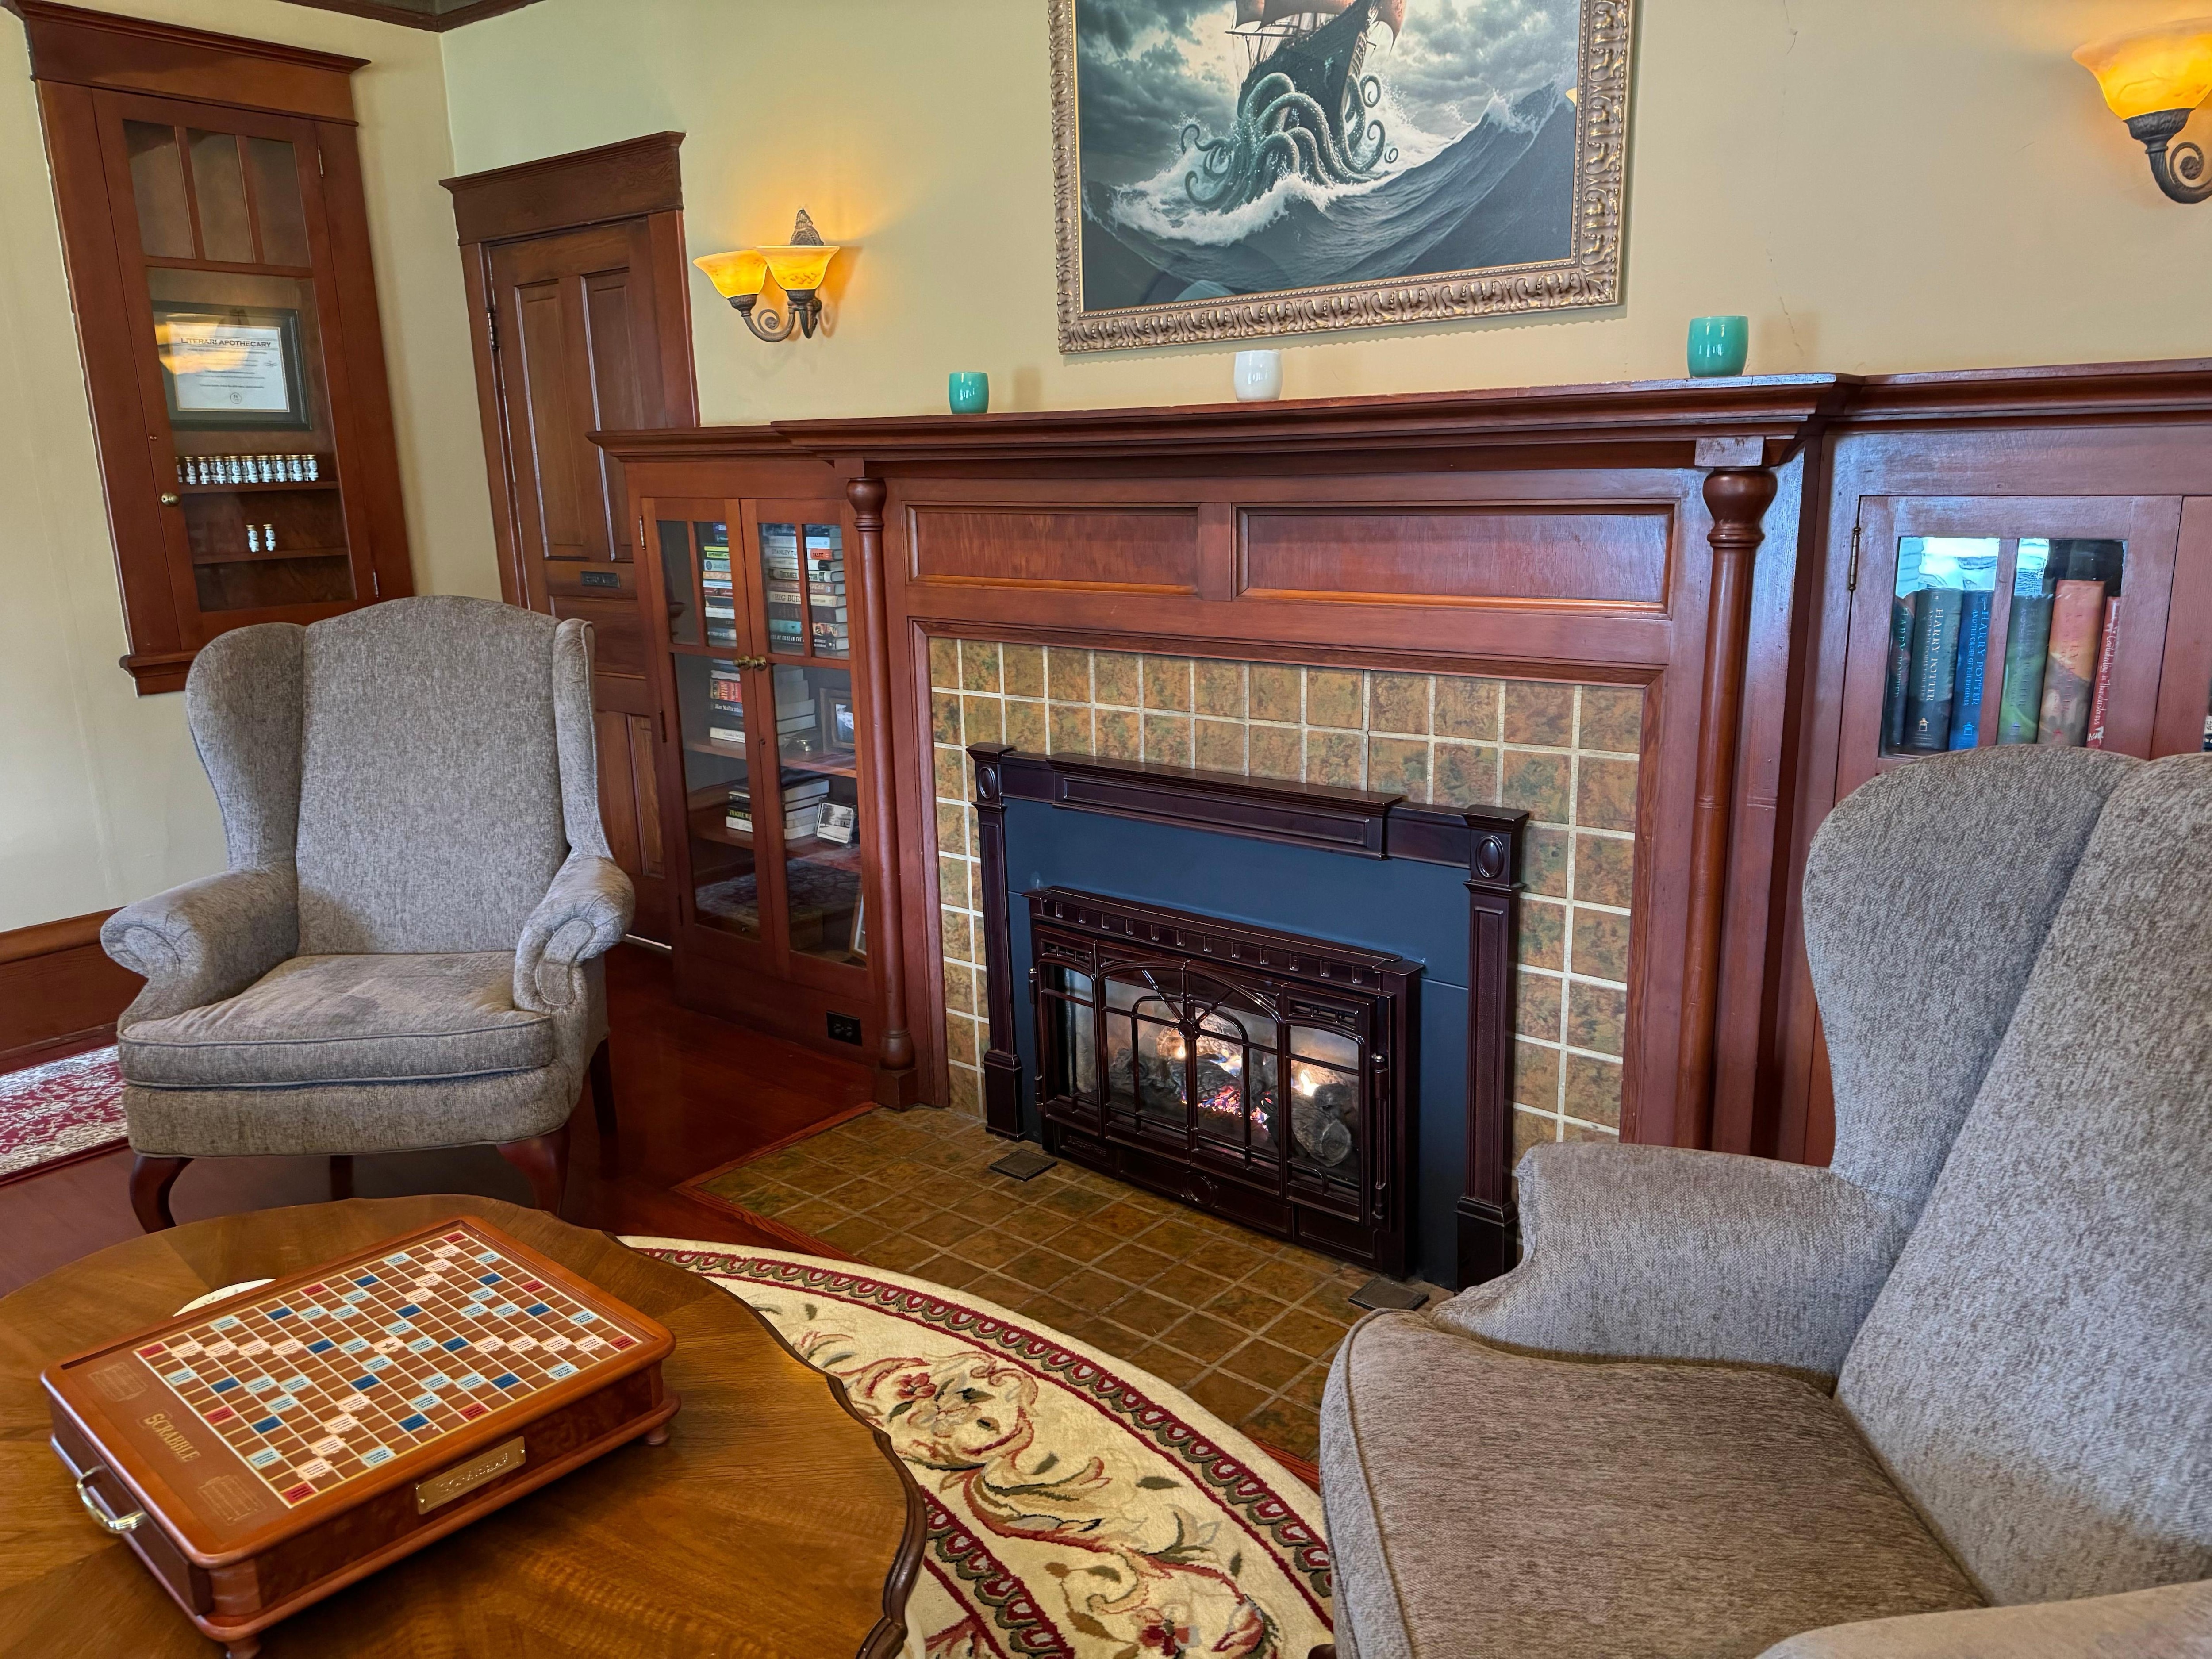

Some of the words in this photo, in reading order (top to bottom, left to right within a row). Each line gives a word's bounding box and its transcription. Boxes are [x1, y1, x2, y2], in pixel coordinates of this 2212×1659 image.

[1932, 608, 1943, 653] HARRY
[1978, 610, 1989, 656] HARRY
[2100, 635, 2116, 673] Cartwheeling
[1926, 658, 1938, 701] POTTER
[1971, 662, 1983, 705] POTTER
[2094, 682, 2111, 725] Thunderstorms
[144, 1413, 200, 1462] SCRABBLE
